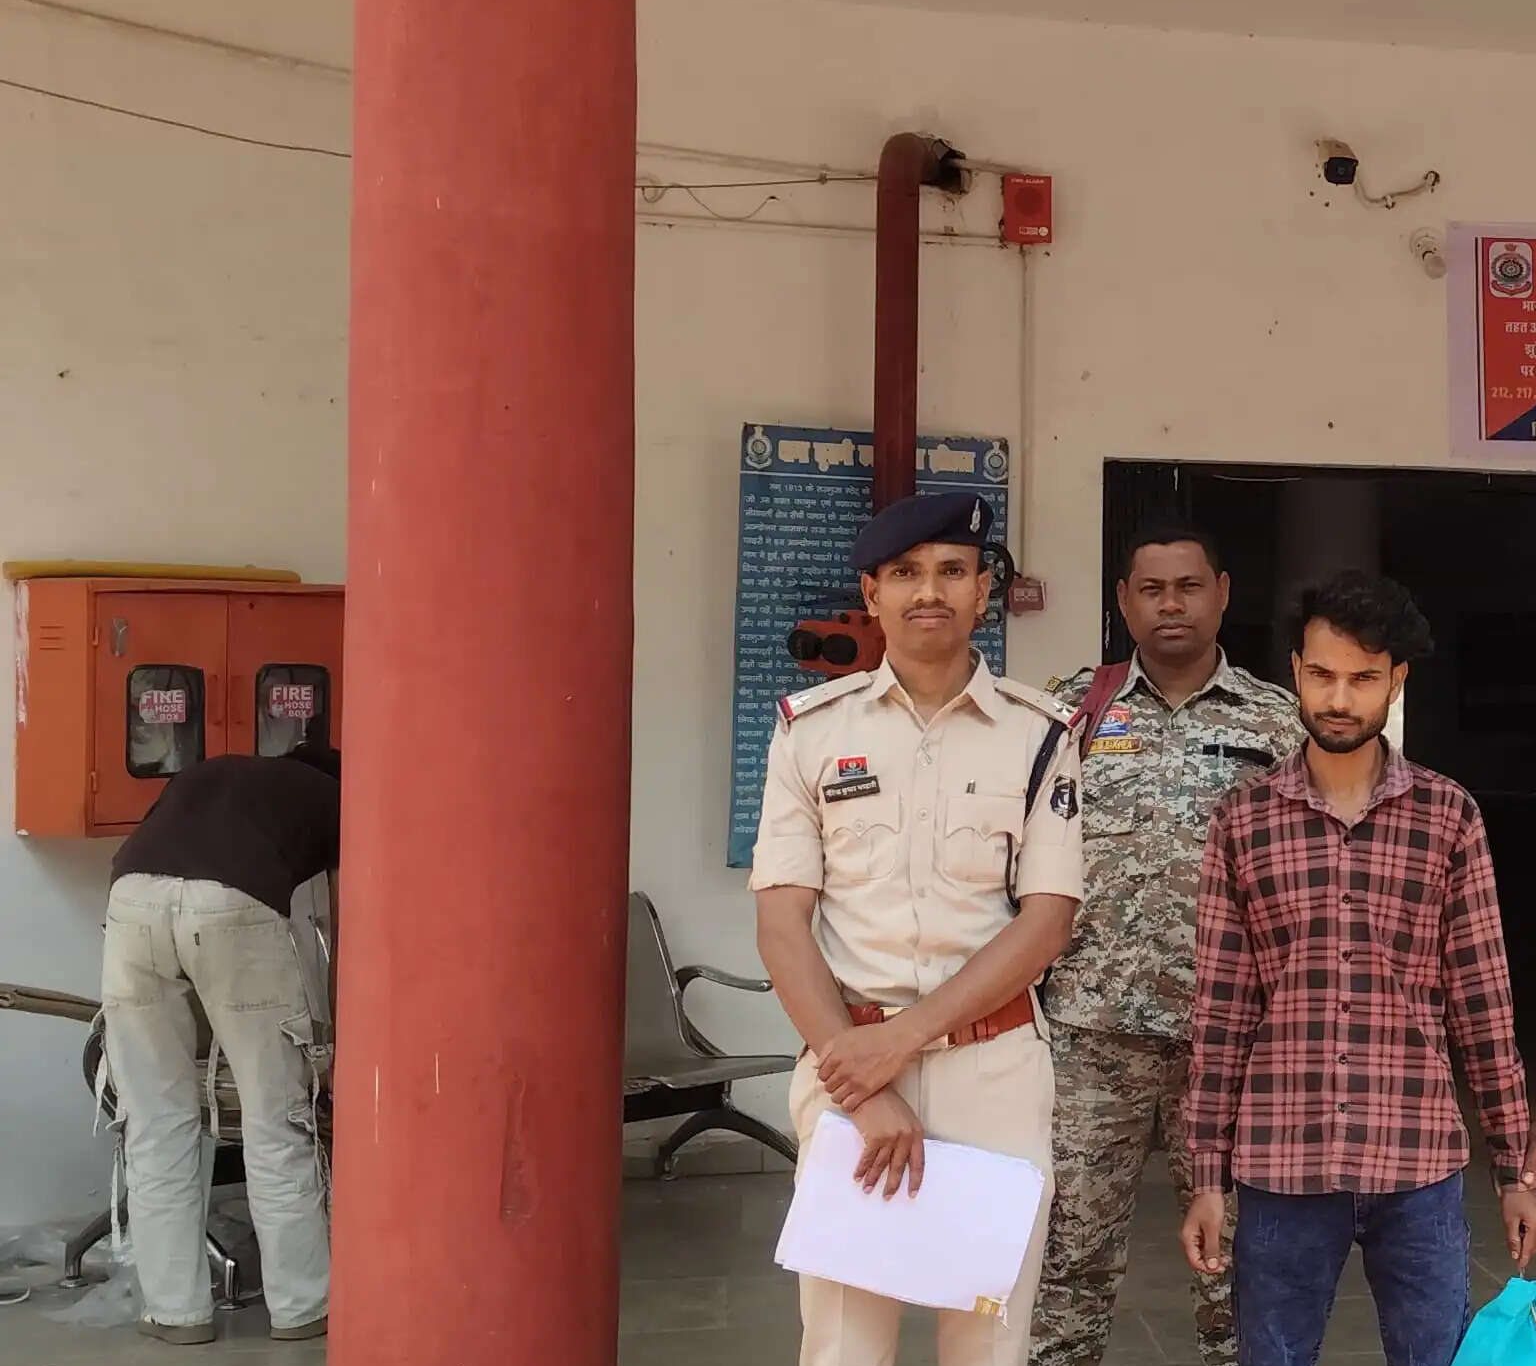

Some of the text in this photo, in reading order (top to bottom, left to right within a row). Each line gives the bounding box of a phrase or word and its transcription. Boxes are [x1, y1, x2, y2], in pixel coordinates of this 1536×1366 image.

[1505, 322, 1528, 333] तहत
[1520, 365, 1535, 377] पर
[272, 686, 314, 701] FIRE
[155, 704, 184, 713] HOSE
[284, 701, 312, 710] HOSE
[160, 713, 180, 721] BOX
